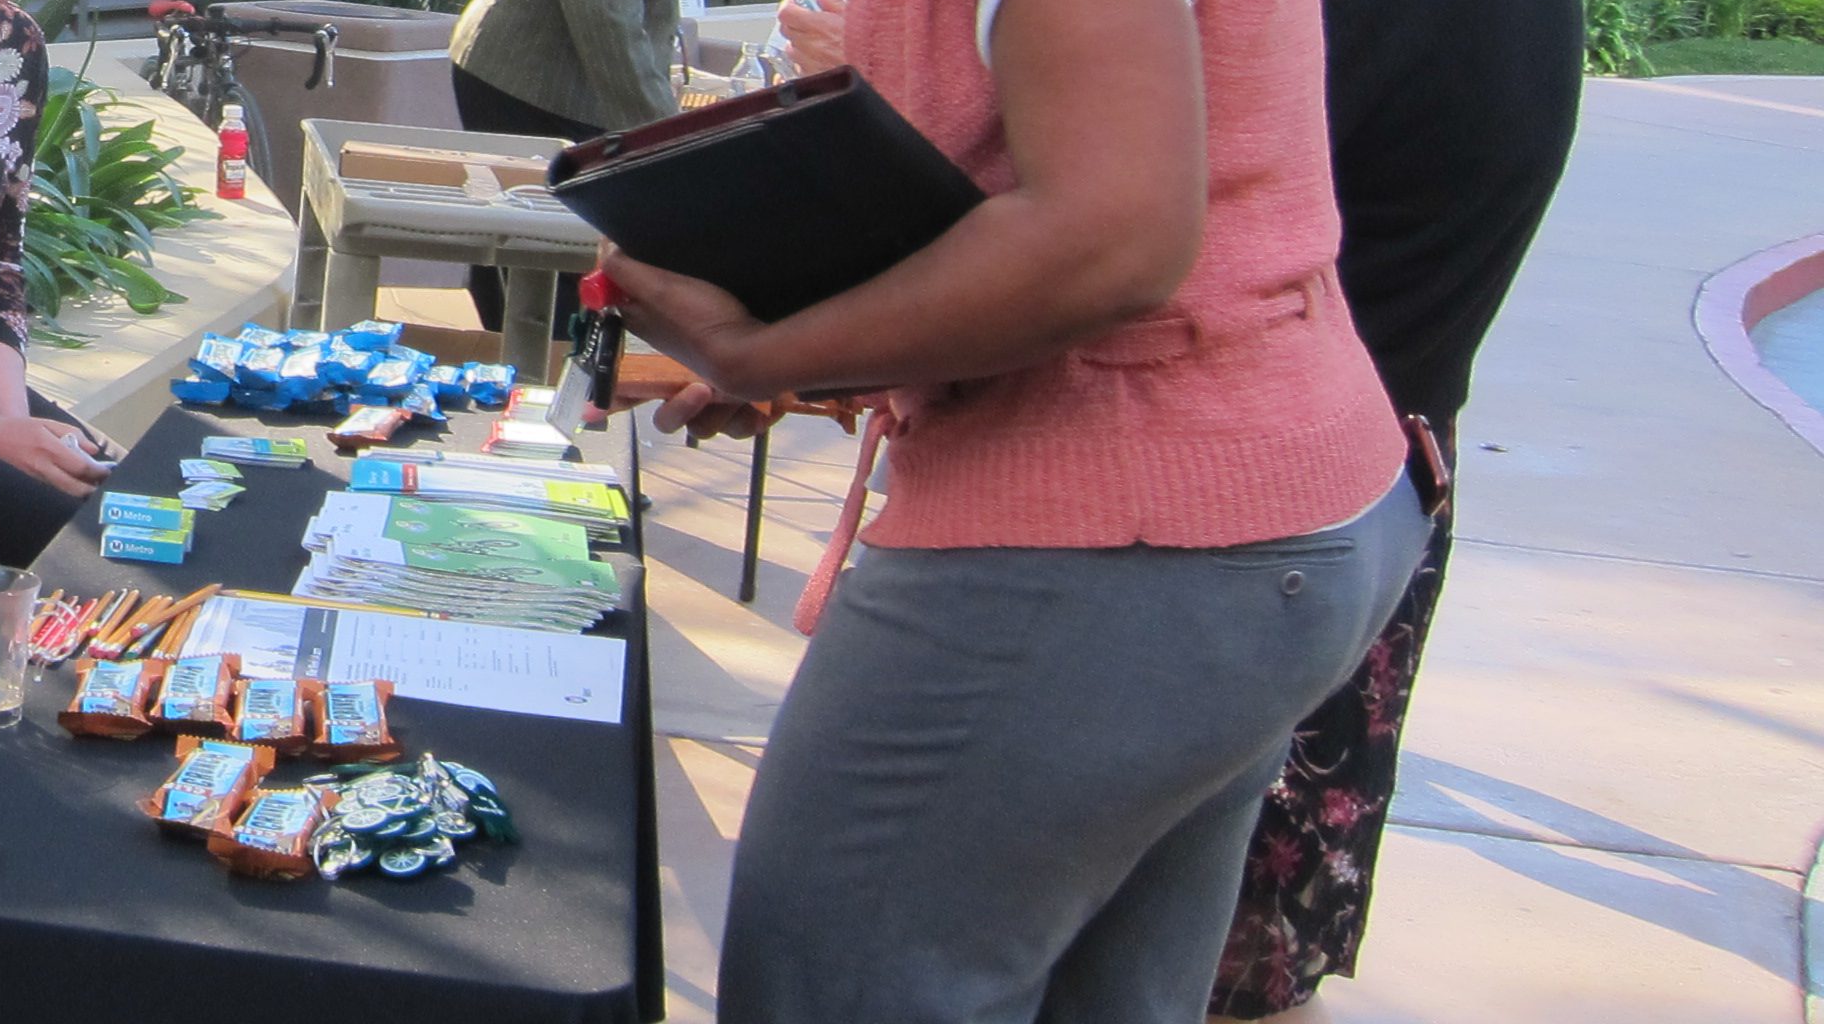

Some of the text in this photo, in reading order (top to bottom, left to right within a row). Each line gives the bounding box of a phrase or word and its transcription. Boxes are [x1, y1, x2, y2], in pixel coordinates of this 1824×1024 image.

[123, 510, 152, 522] Metro
[125, 543, 154, 554] Metro
[180, 751, 231, 788] CRUNCH
